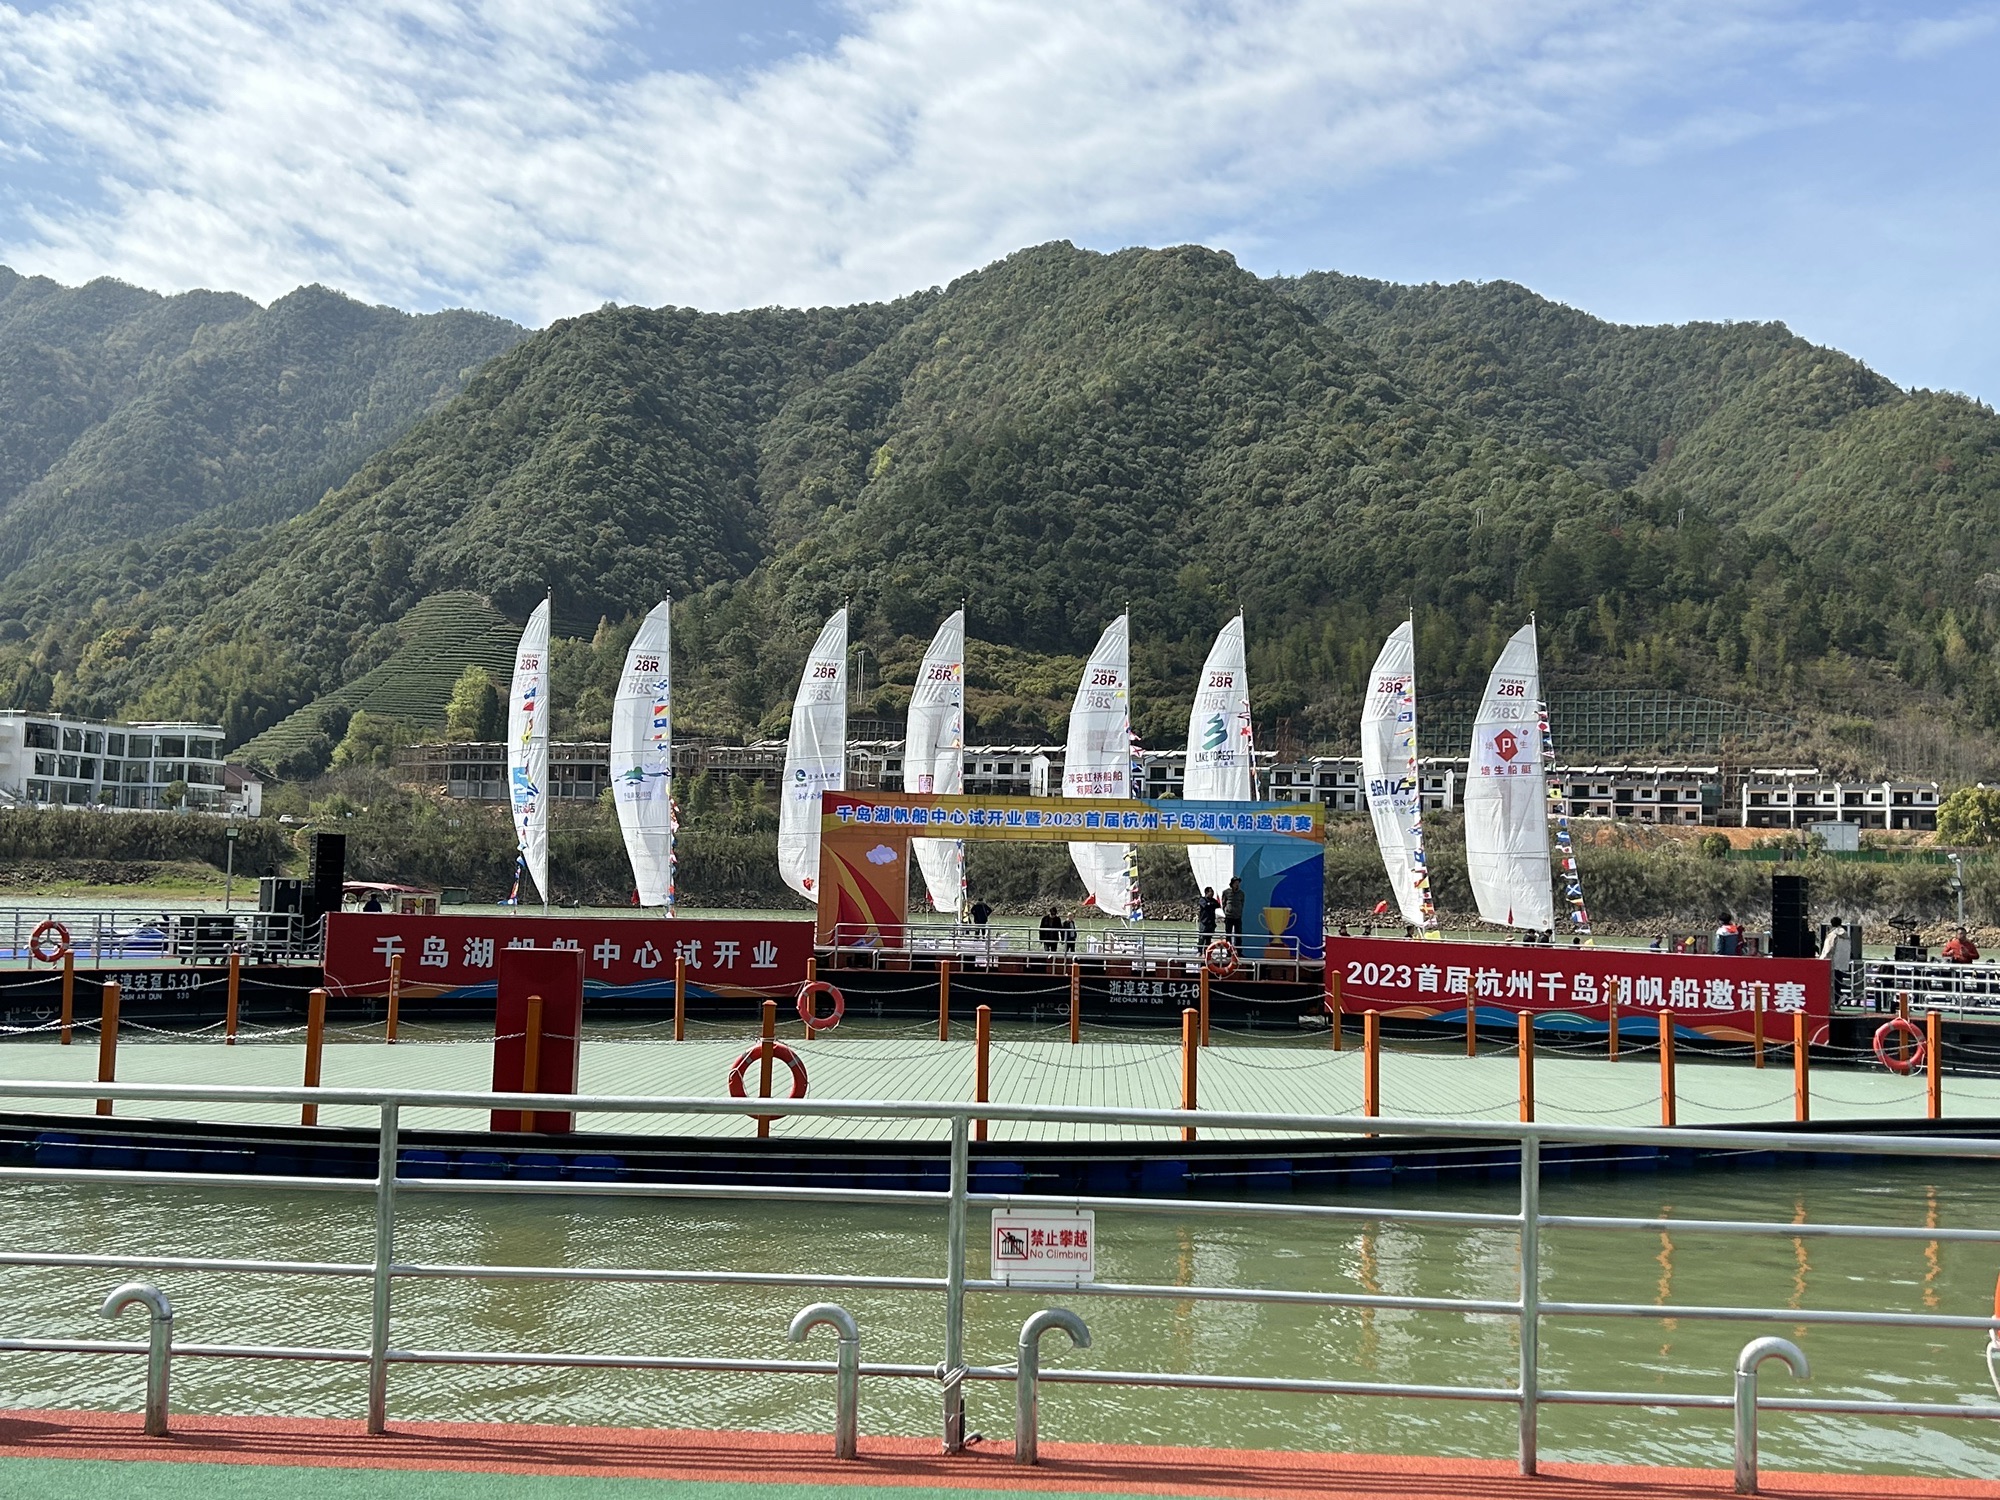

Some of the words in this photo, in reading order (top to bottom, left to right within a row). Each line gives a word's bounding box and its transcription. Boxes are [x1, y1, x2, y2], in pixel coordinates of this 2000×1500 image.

[520, 659, 539, 671] 28R
[634, 660, 660, 673] 28R
[812, 667, 837, 679] 28R
[927, 668, 953, 682] 28R
[1091, 673, 1117, 687] 28R
[1208, 676, 1233, 689] 28R
[1377, 681, 1403, 694] 28R
[1497, 684, 1525, 697] 28R
[1076, 783, 1113, 795] 有限公司
[1346, 961, 1806, 1013] 2023首届杭州千岛湖帆船邀请赛
[1030, 1229, 1088, 1248] 禁止攀越
[1030, 1249, 1044, 1259] No
[1046, 1249, 1088, 1261] Climbing
